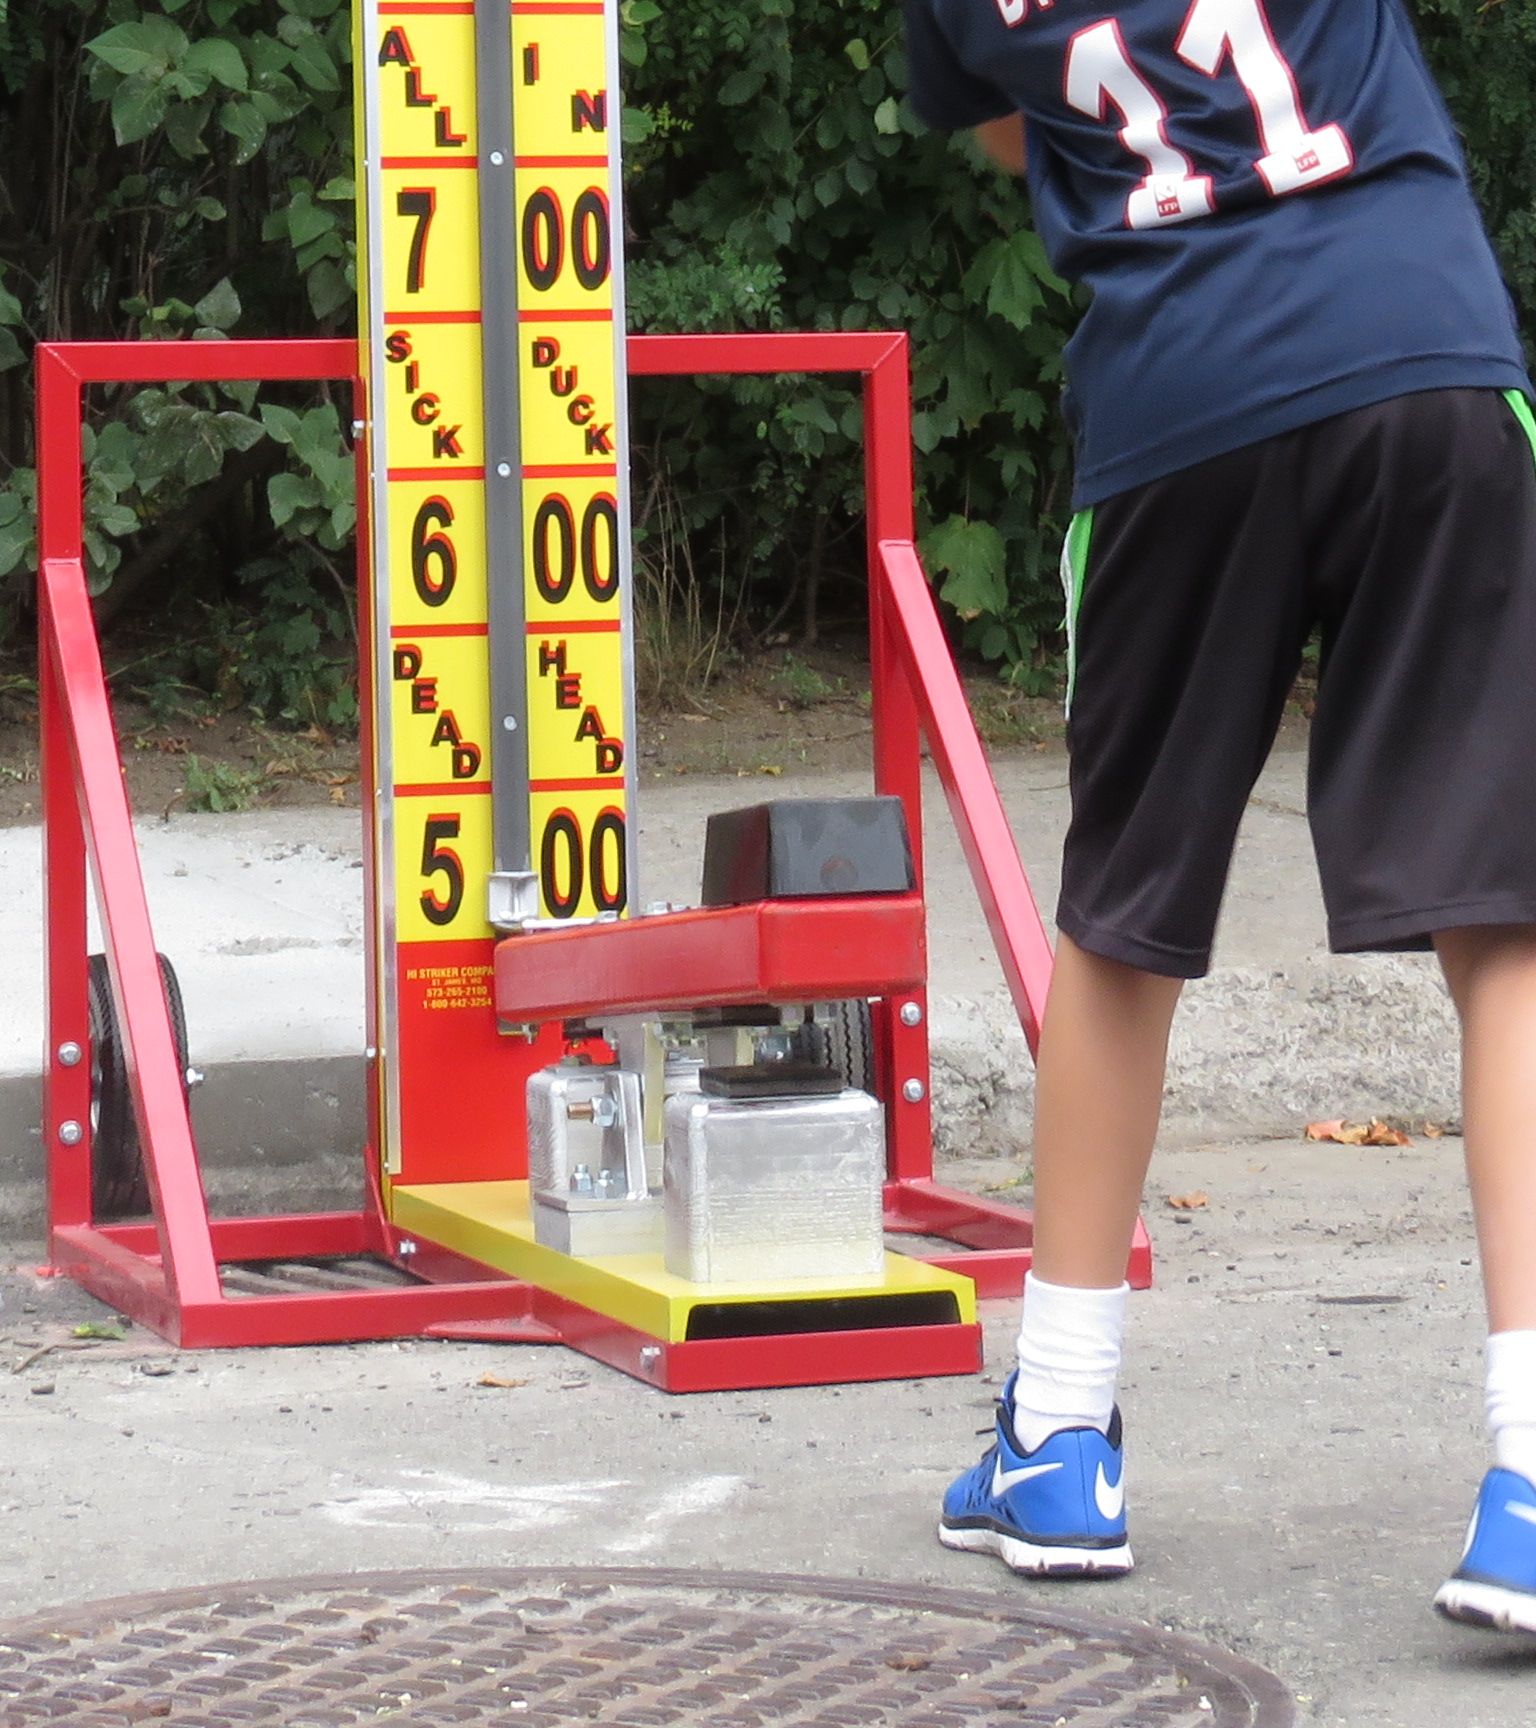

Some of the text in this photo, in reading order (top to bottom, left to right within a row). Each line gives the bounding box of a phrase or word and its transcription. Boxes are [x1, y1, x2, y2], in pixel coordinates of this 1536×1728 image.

[379, 25, 607, 147] ALL IN
[397, 186, 611, 294] 7 00
[386, 330, 614, 459] SICK DUCK
[412, 492, 619, 608] 6 00
[393, 640, 624, 779] DEAD HEAD
[420, 805, 626, 926] 5 00
[419, 967, 459, 979] STRIKER
[461, 965, 494, 977] COMPA
